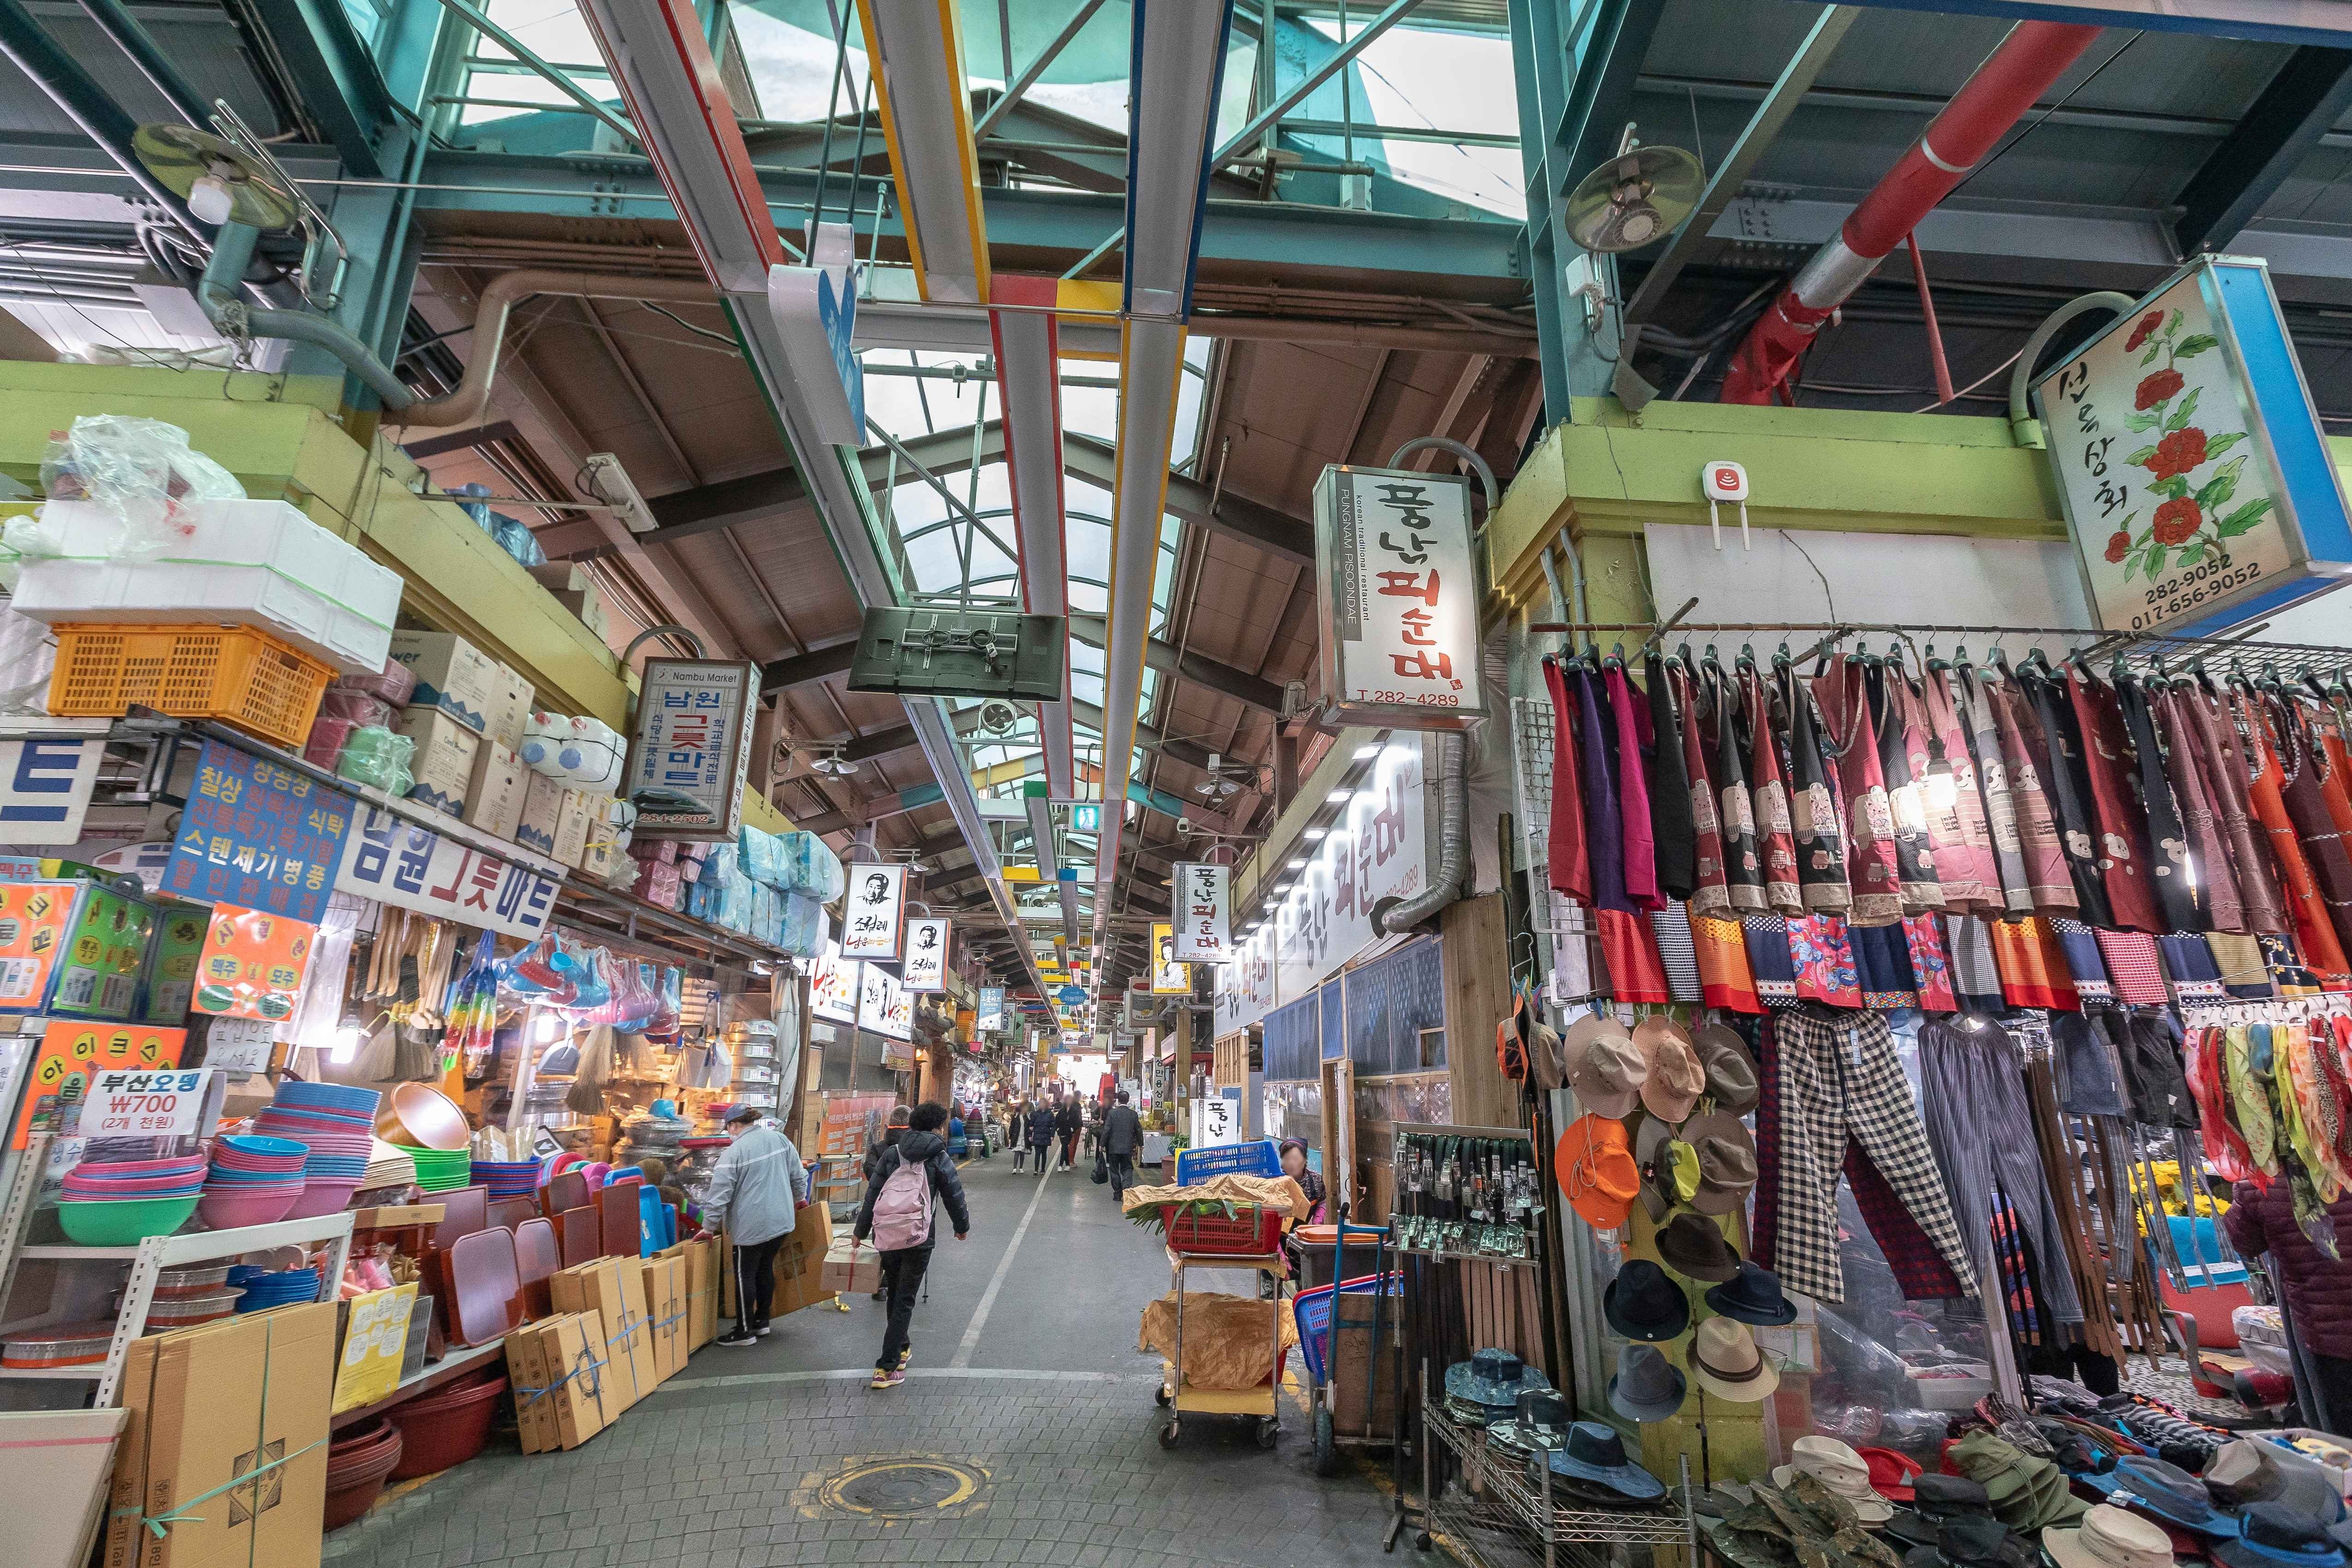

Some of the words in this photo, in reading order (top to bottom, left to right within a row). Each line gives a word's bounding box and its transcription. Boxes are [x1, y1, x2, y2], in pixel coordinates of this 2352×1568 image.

[1341, 488, 1352, 548] PUNGNAM
[1375, 483, 1438, 565] 풍남
[1345, 553, 1357, 625] PISOONDAE
[1361, 575, 1369, 621] restaurant
[2131, 562, 2260, 631] 017-656-9052
[2145, 554, 2233, 604] 282-9052
[1376, 569, 1452, 679] 피순대
[673, 672, 705, 681] Nambu
[707, 673, 737, 683] Market
[664, 691, 720, 709] 남원
[1357, 689, 1458, 707] T.282-4289
[664, 714, 708, 787] 그릇마트
[200, 767, 243, 803] 칠상
[309, 809, 344, 839] 식탁
[639, 814, 708, 823] 284-2502
[283, 858, 325, 890] 병풍
[1194, 868, 1217, 903] 풍남
[855, 915, 887, 932] 조점례
[1192, 903, 1219, 948] 피순대
[100, 1073, 200, 1093] 부산오뎅
[138, 1116, 175, 1129] 천원)
[1207, 1103, 1228, 1137] 풍남
